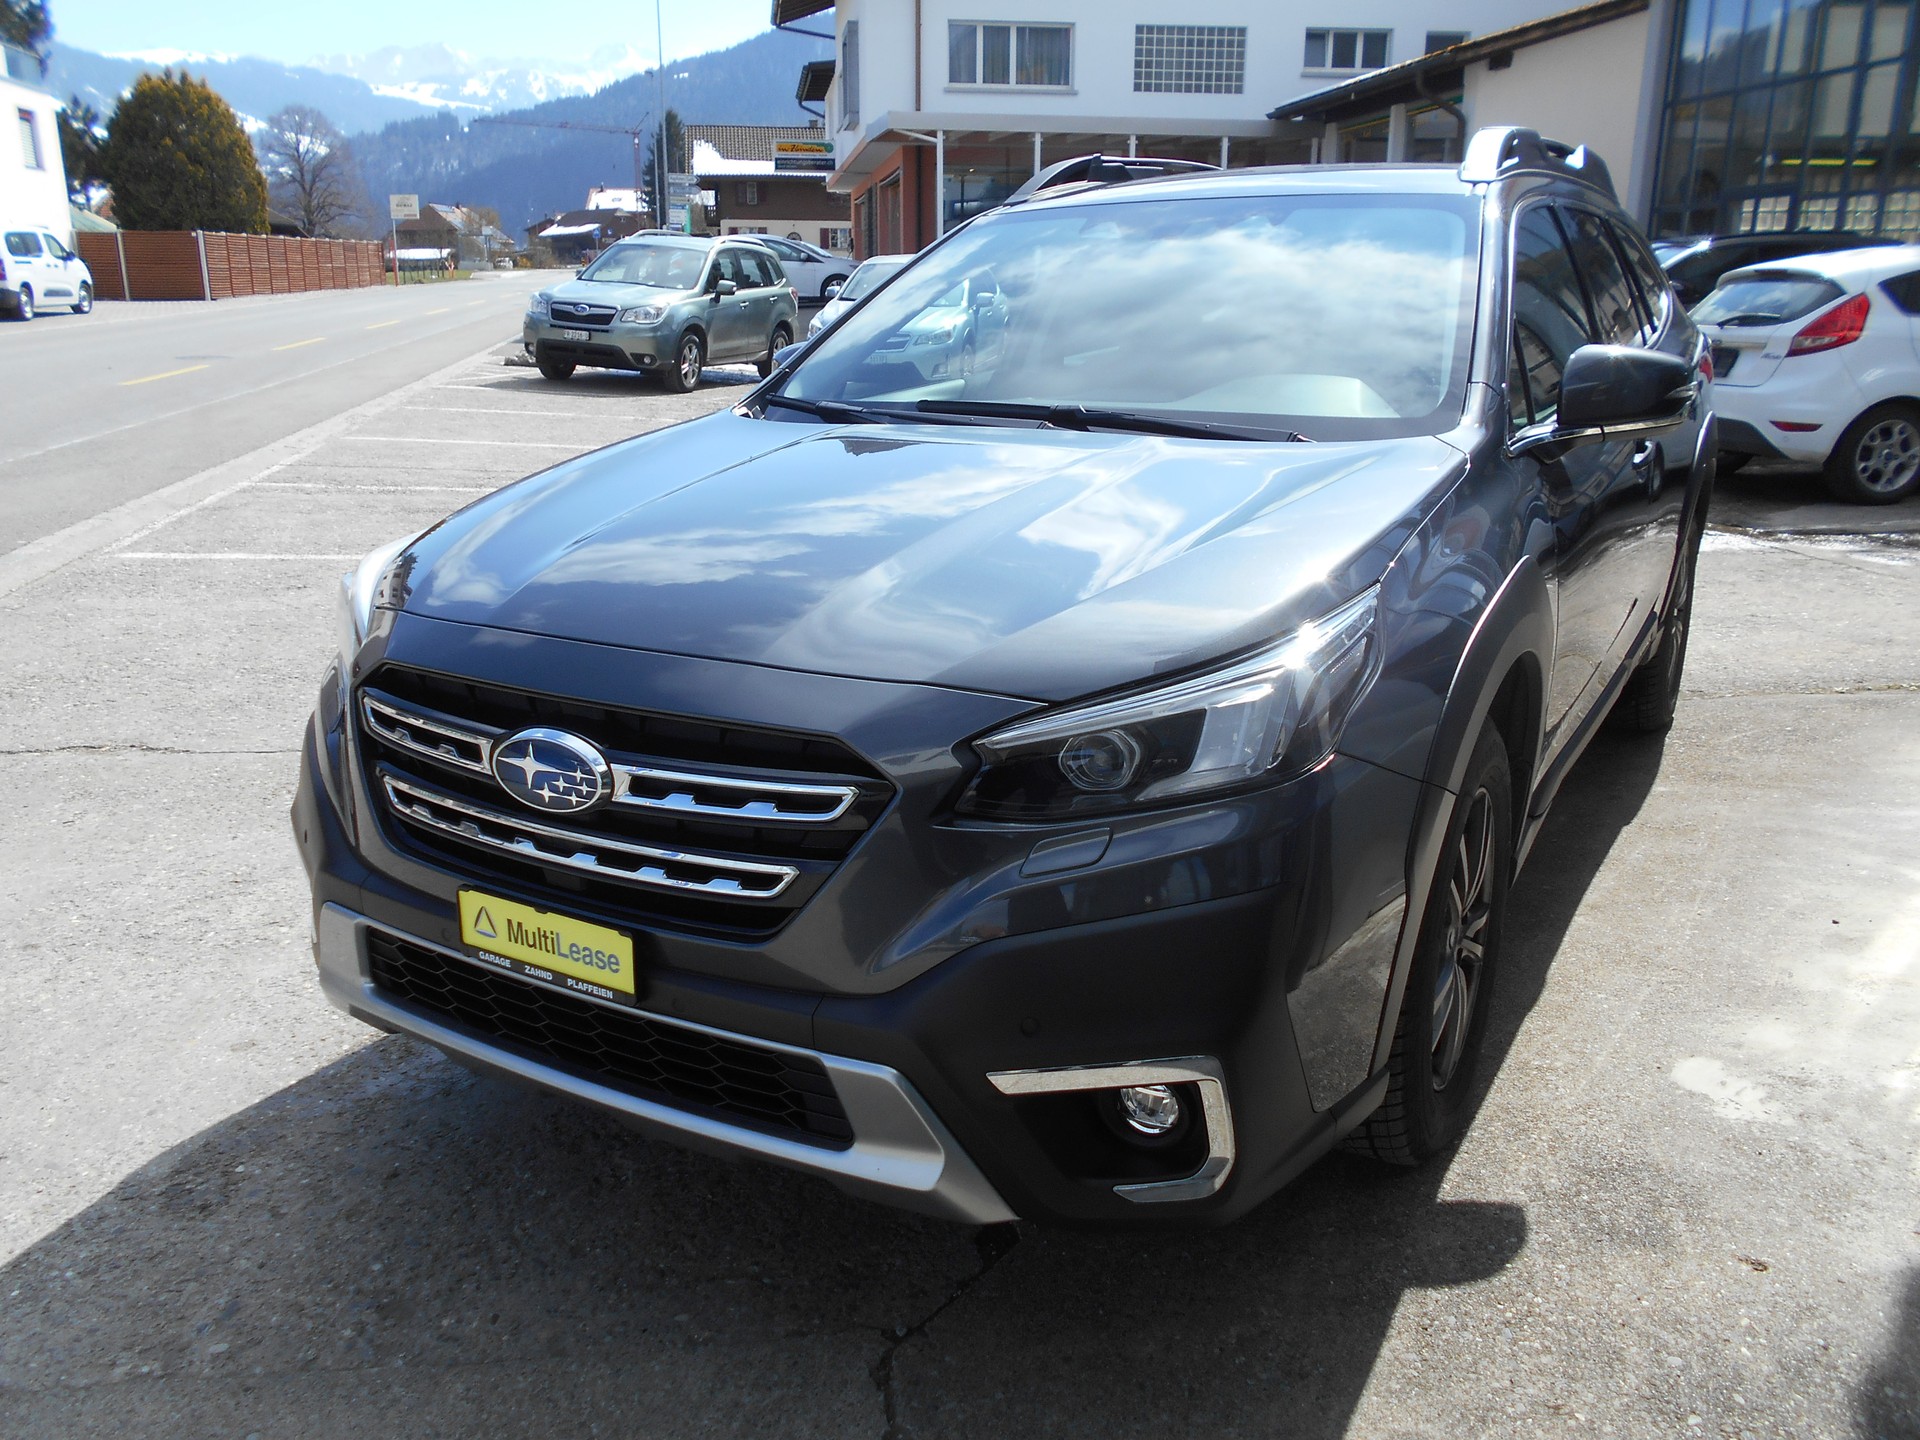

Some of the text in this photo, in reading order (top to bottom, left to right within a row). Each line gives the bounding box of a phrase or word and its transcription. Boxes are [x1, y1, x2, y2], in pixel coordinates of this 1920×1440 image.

[506, 918, 620, 974] MultiLease
[479, 951, 613, 999] GARAGE ZAHND PLAFFEIEN
